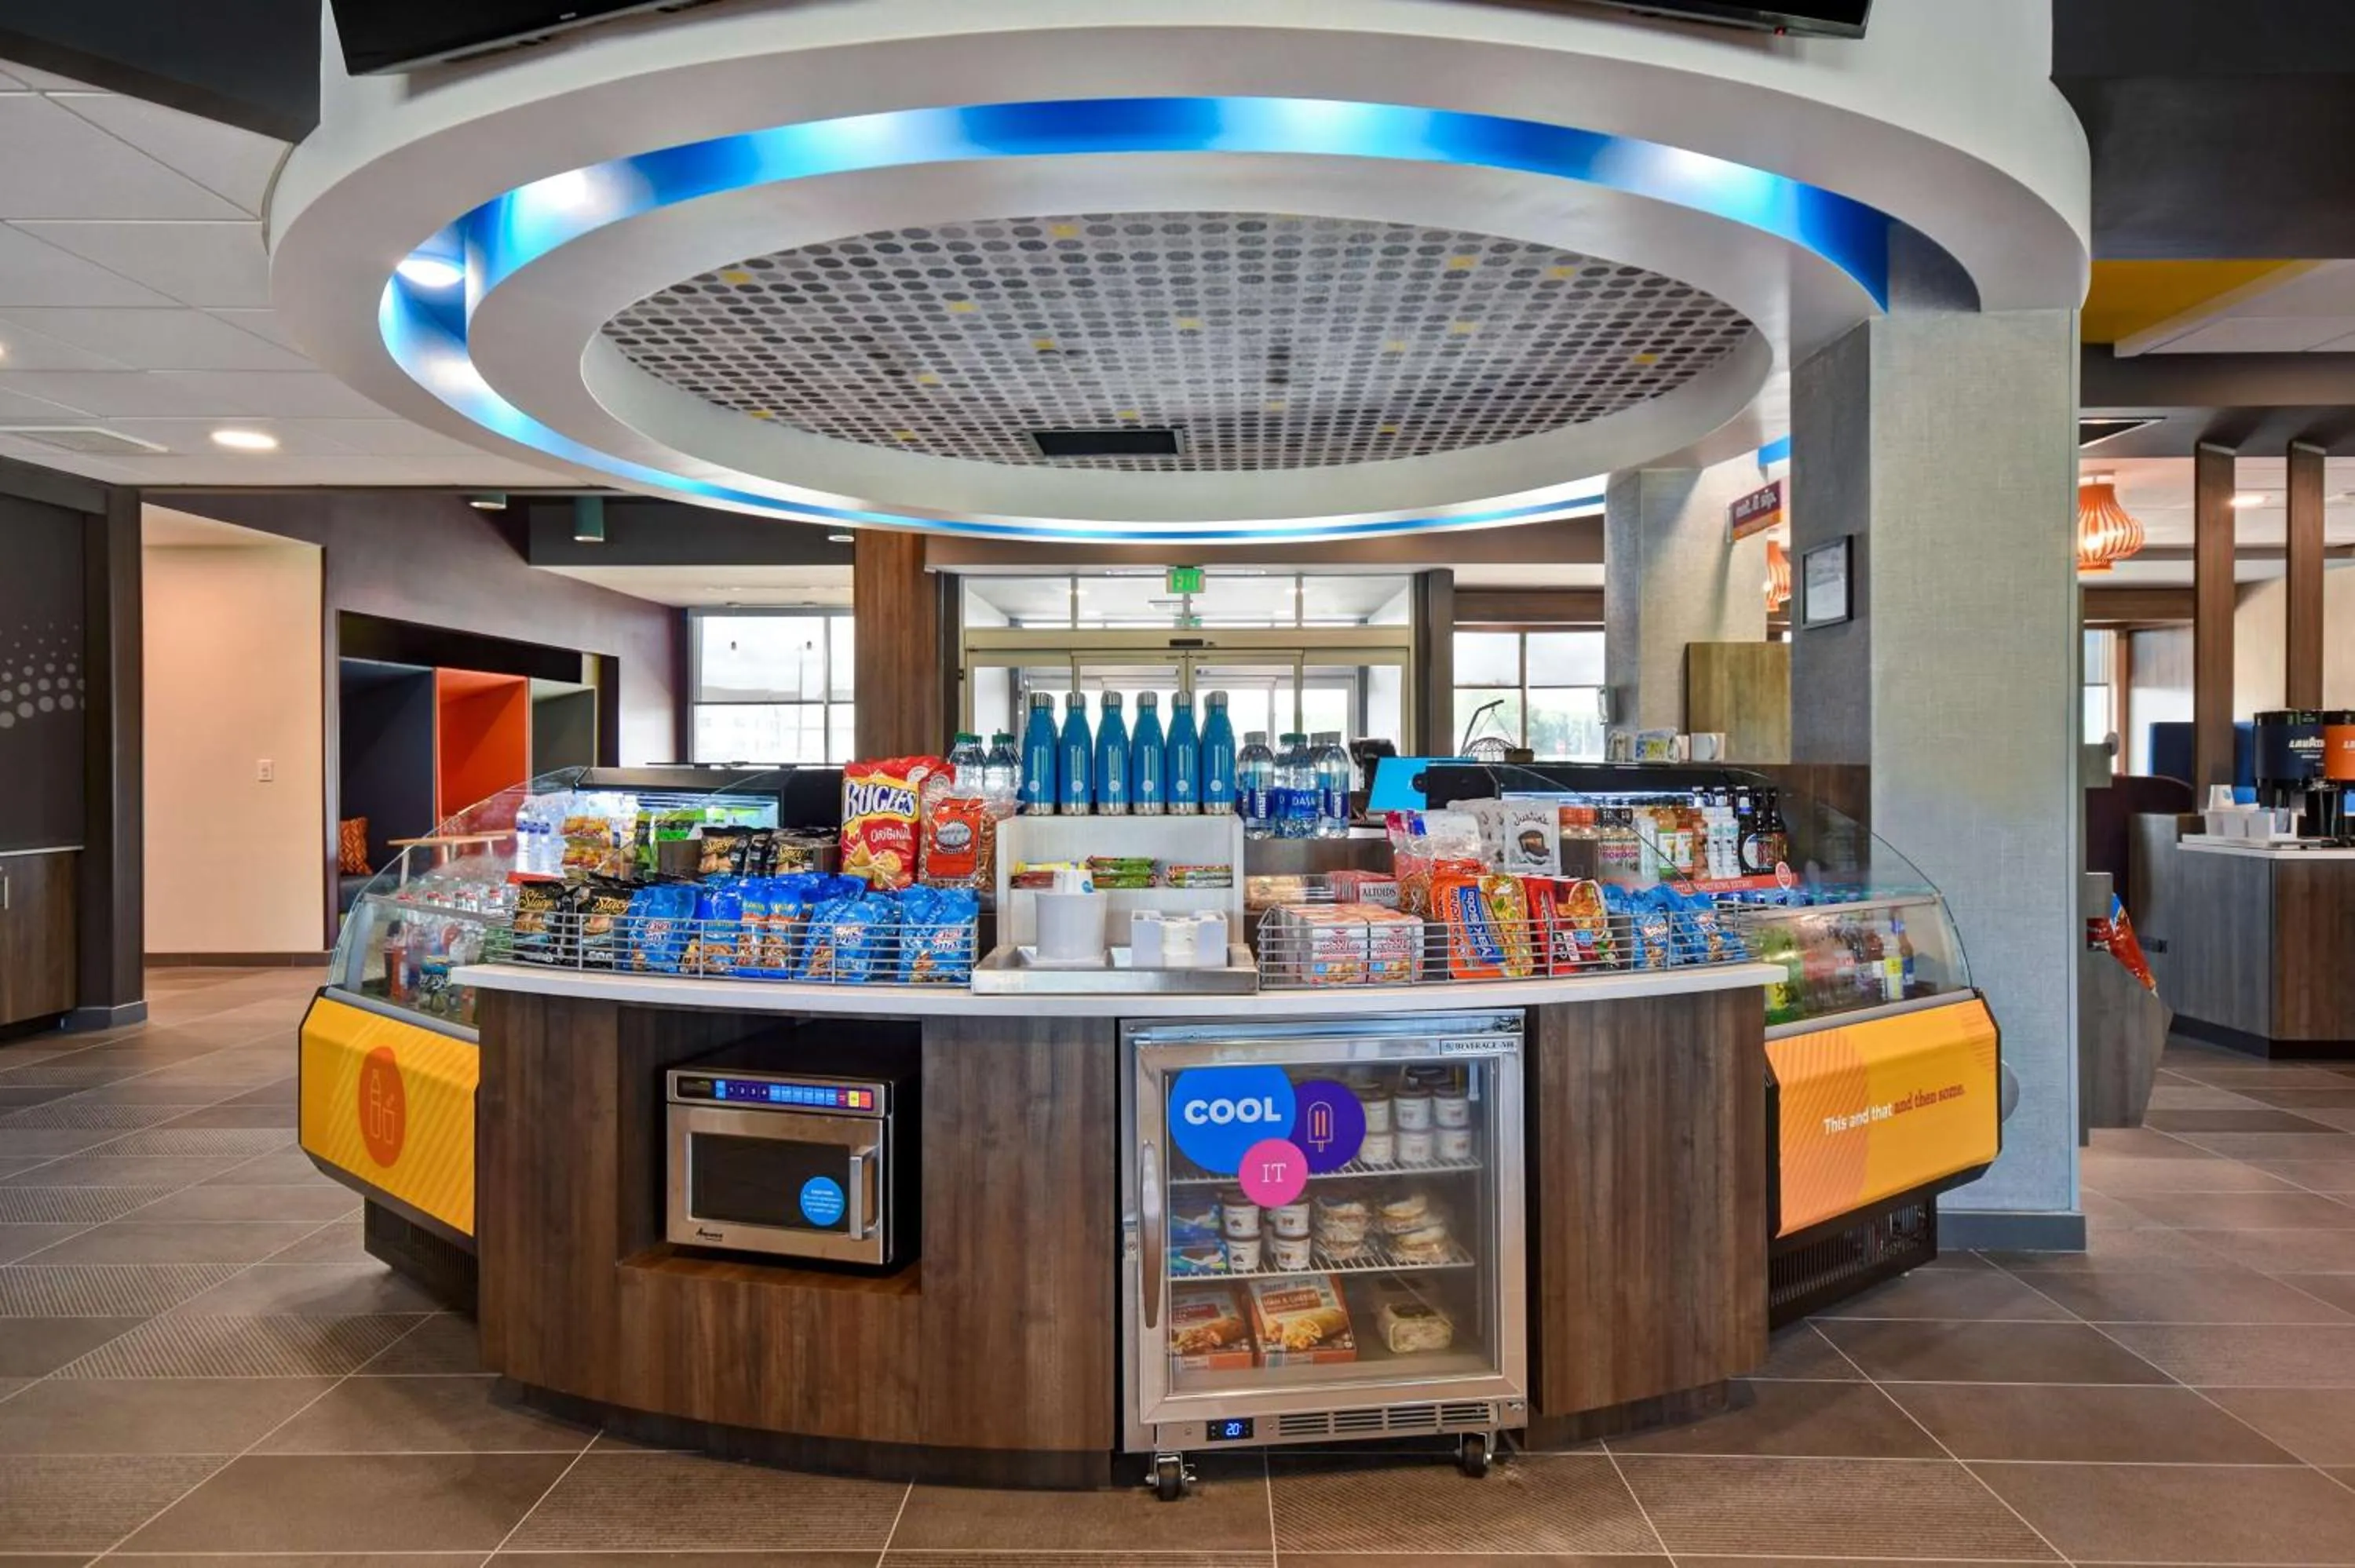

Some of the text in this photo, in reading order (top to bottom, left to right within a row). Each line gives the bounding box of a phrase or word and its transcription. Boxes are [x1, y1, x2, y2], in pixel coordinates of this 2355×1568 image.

[843, 779, 917, 824] BUGLES
[1363, 887, 1397, 898] ALTOIDS
[1184, 1096, 1282, 1125] COOL
[1823, 1084, 1965, 1135] This and that and then some.
[1261, 1163, 1287, 1183] IT
